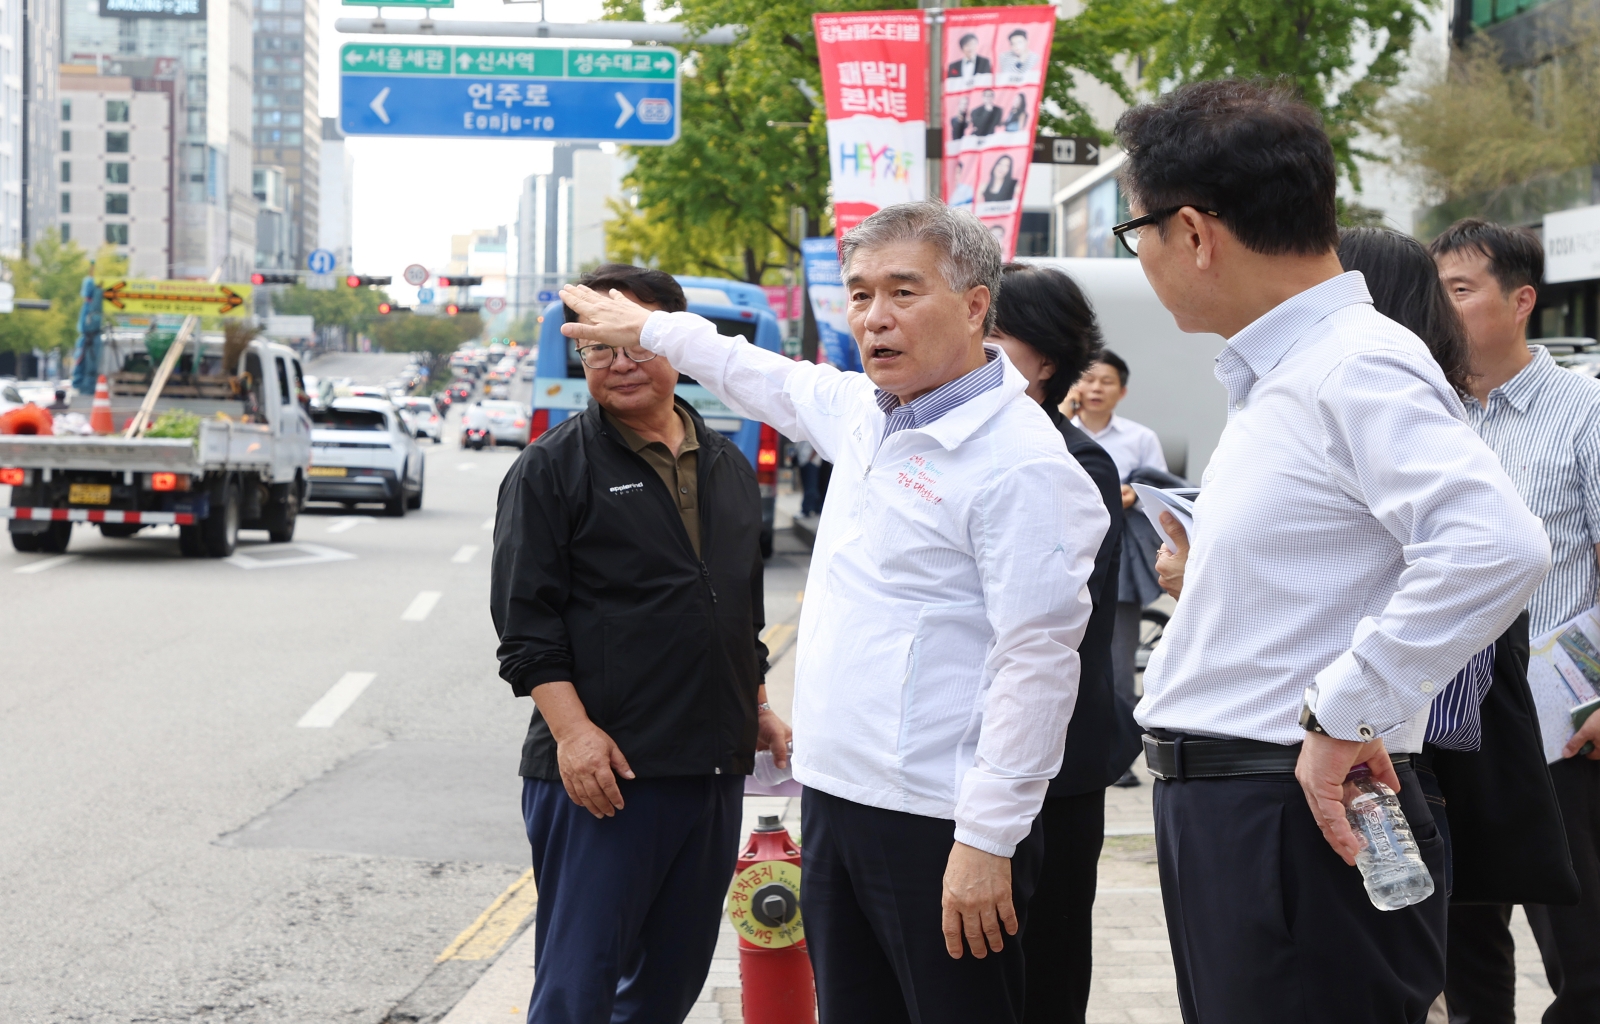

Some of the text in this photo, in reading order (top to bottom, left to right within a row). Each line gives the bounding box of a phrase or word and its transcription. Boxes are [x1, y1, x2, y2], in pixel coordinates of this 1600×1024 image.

[820, 24, 920, 43] 강남페스티벌
[365, 48, 446, 71] 서울세관
[475, 51, 535, 73] 신사역
[574, 53, 653, 74] 성수대교
[837, 61, 907, 89] 패밀리
[467, 82, 551, 110] 언주로
[841, 87, 908, 117] 콘서트
[463, 111, 555, 133] Eonju-ro
[840, 141, 889, 186] HEY
[896, 472, 913, 488] 강남
